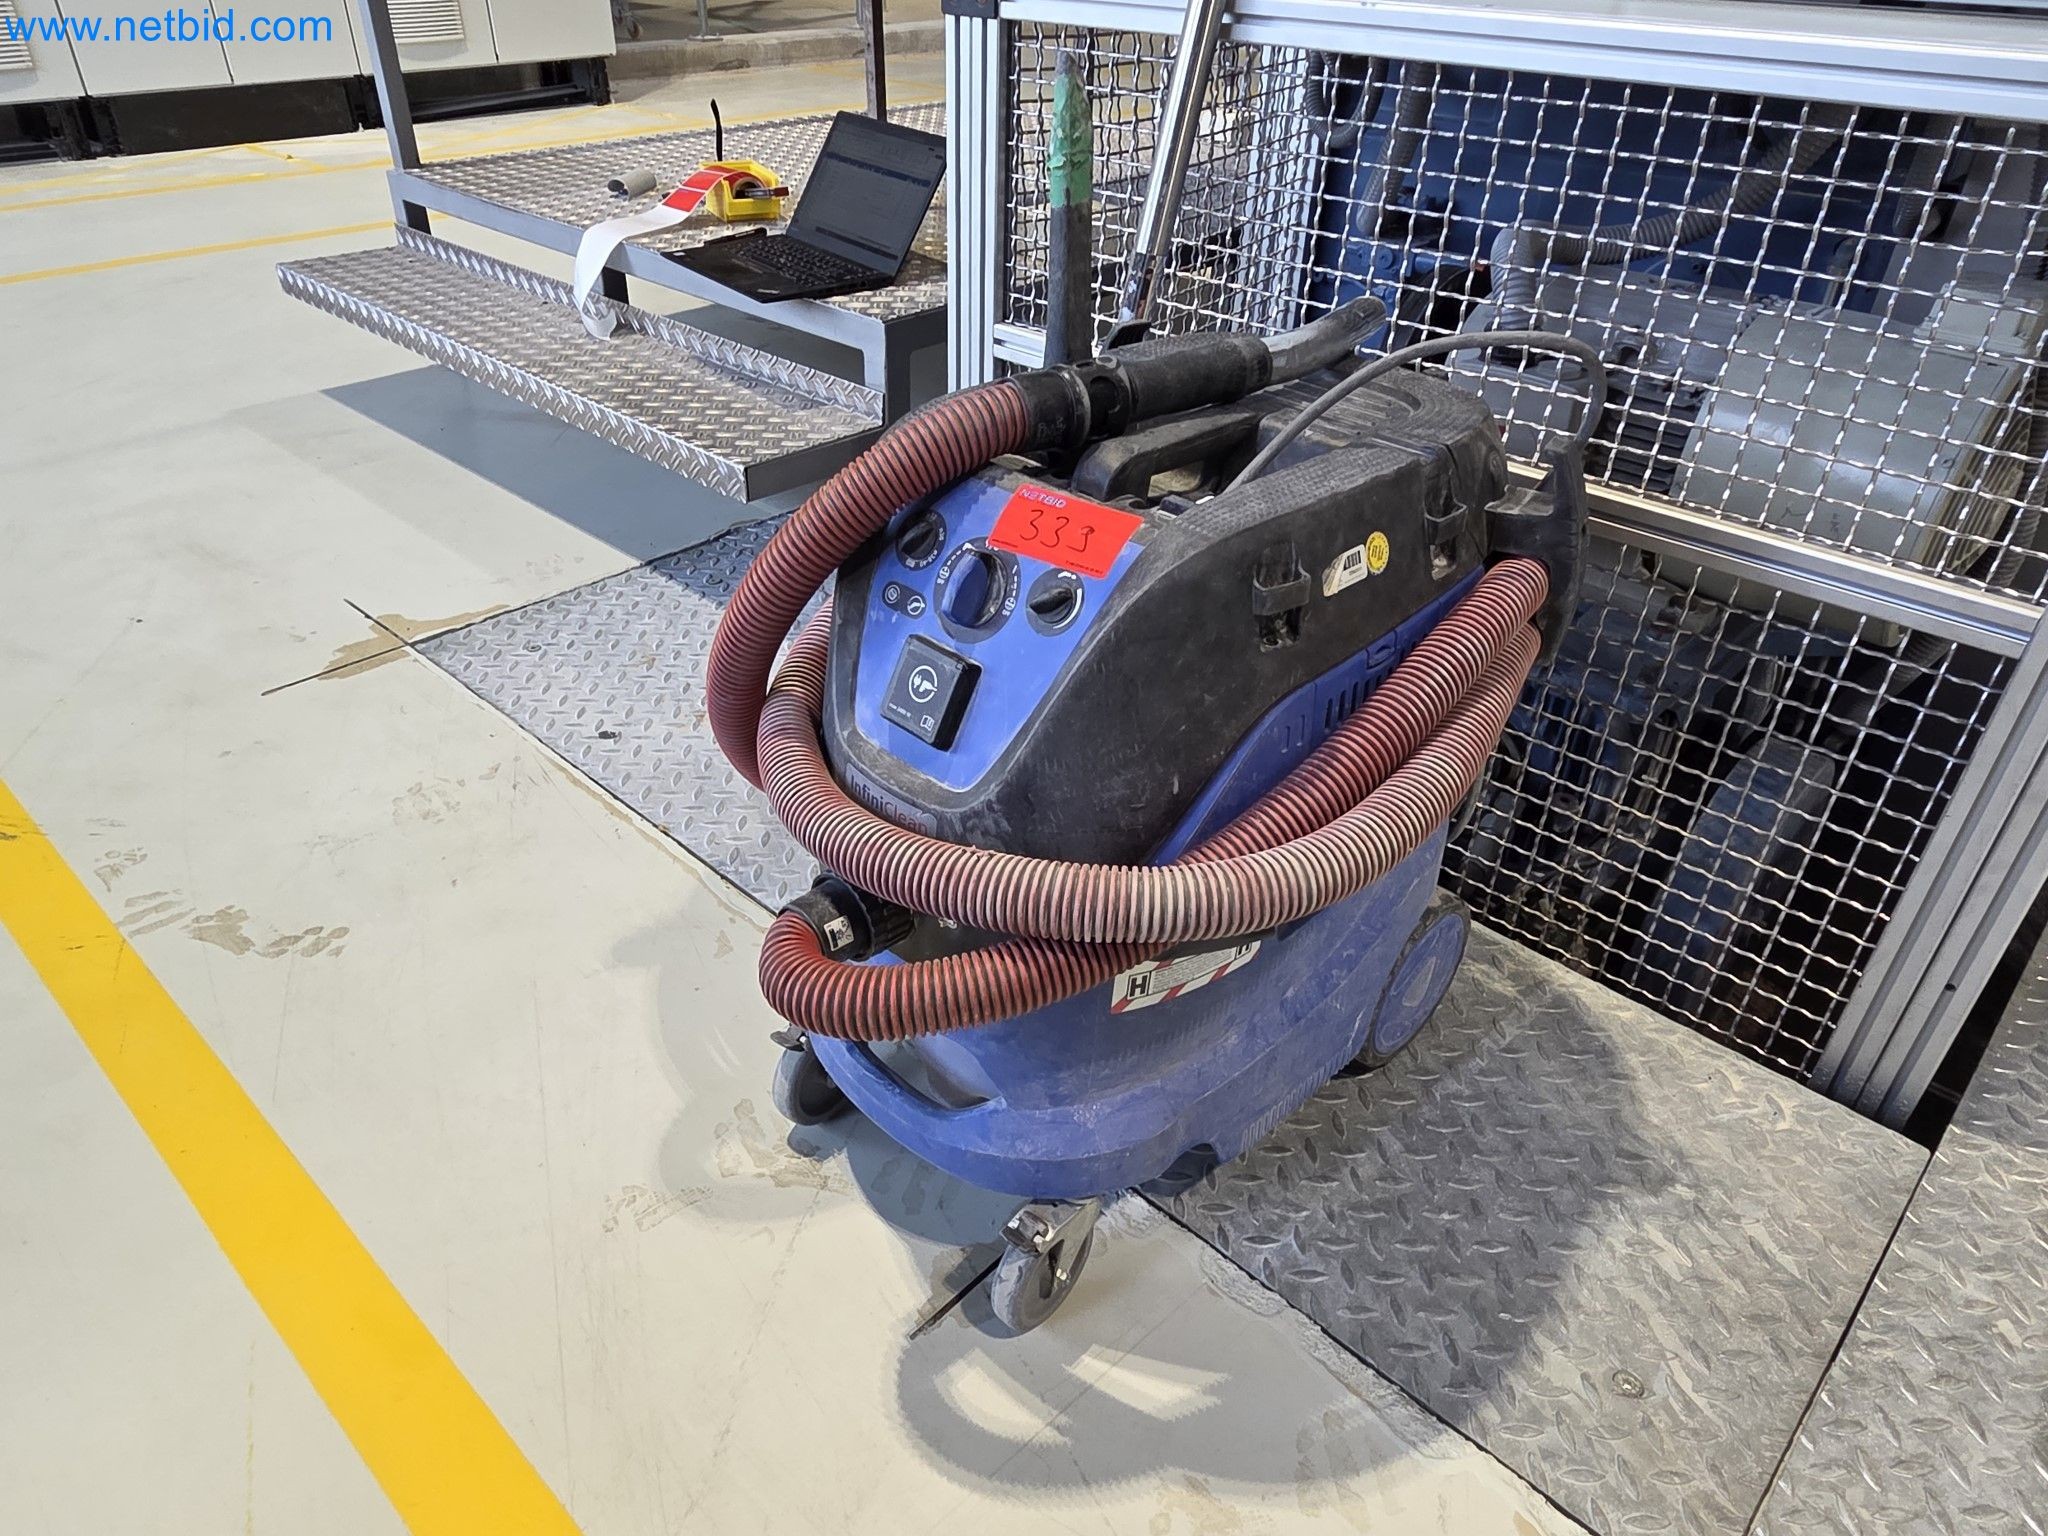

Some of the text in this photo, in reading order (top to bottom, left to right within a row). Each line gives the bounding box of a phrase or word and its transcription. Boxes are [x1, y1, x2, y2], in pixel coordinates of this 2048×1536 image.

[1019, 488, 1066, 508] NETBID
[851, 774, 928, 834] InfiniClean
[1129, 974, 1148, 998] H
